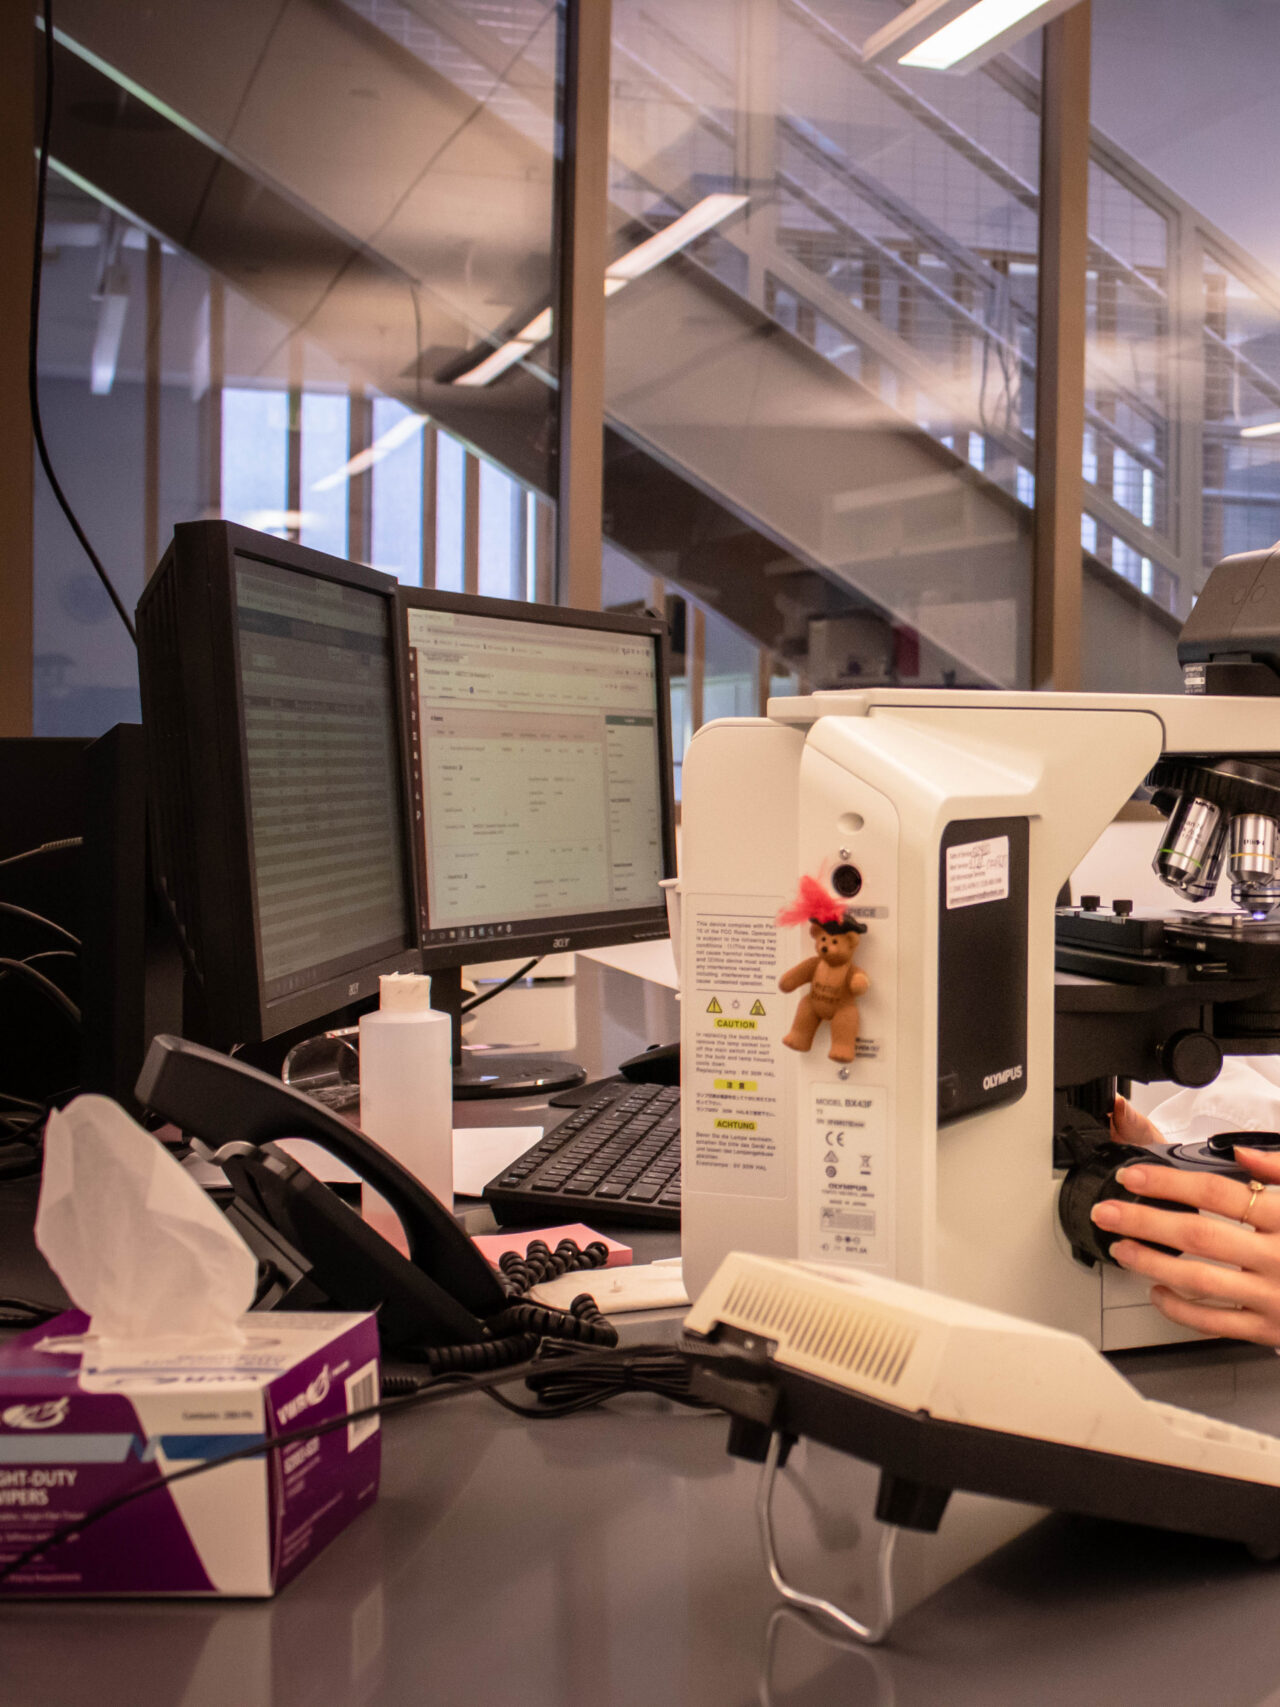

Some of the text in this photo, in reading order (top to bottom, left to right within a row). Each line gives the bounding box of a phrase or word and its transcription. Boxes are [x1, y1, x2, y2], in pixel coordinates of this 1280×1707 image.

[848, 908, 876, 918] PIECE
[716, 1019, 756, 1029] CAUTION
[982, 1065, 1023, 1091] OLYMPUS
[716, 1120, 755, 1130] ACHTUNG
